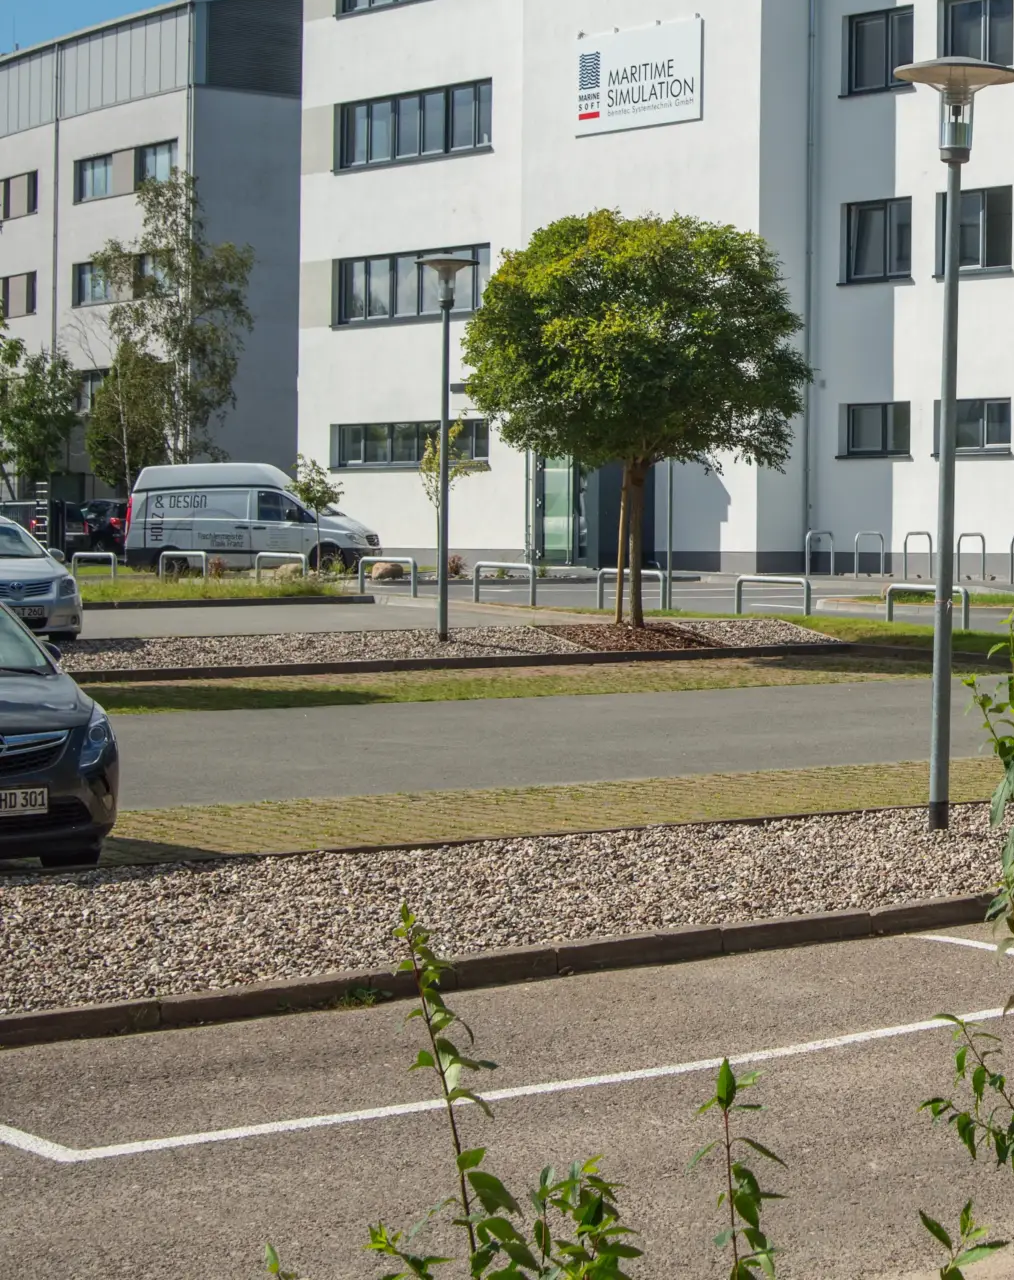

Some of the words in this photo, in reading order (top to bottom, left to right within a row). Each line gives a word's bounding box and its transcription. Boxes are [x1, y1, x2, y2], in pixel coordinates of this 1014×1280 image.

[607, 58, 675, 88] MARITIME
[578, 92, 600, 102] MARINE
[607, 76, 695, 108] SIMULATION
[632, 102, 673, 114] Systemtechnik
[674, 98, 695, 108] GmbH
[154, 495, 165, 509] &
[169, 494, 208, 509] DESIGN
[150, 512, 164, 542] HOLZ
[27, 607, 43, 617] 260
[0, 791, 17, 809] HD
[20, 790, 46, 808] 301
